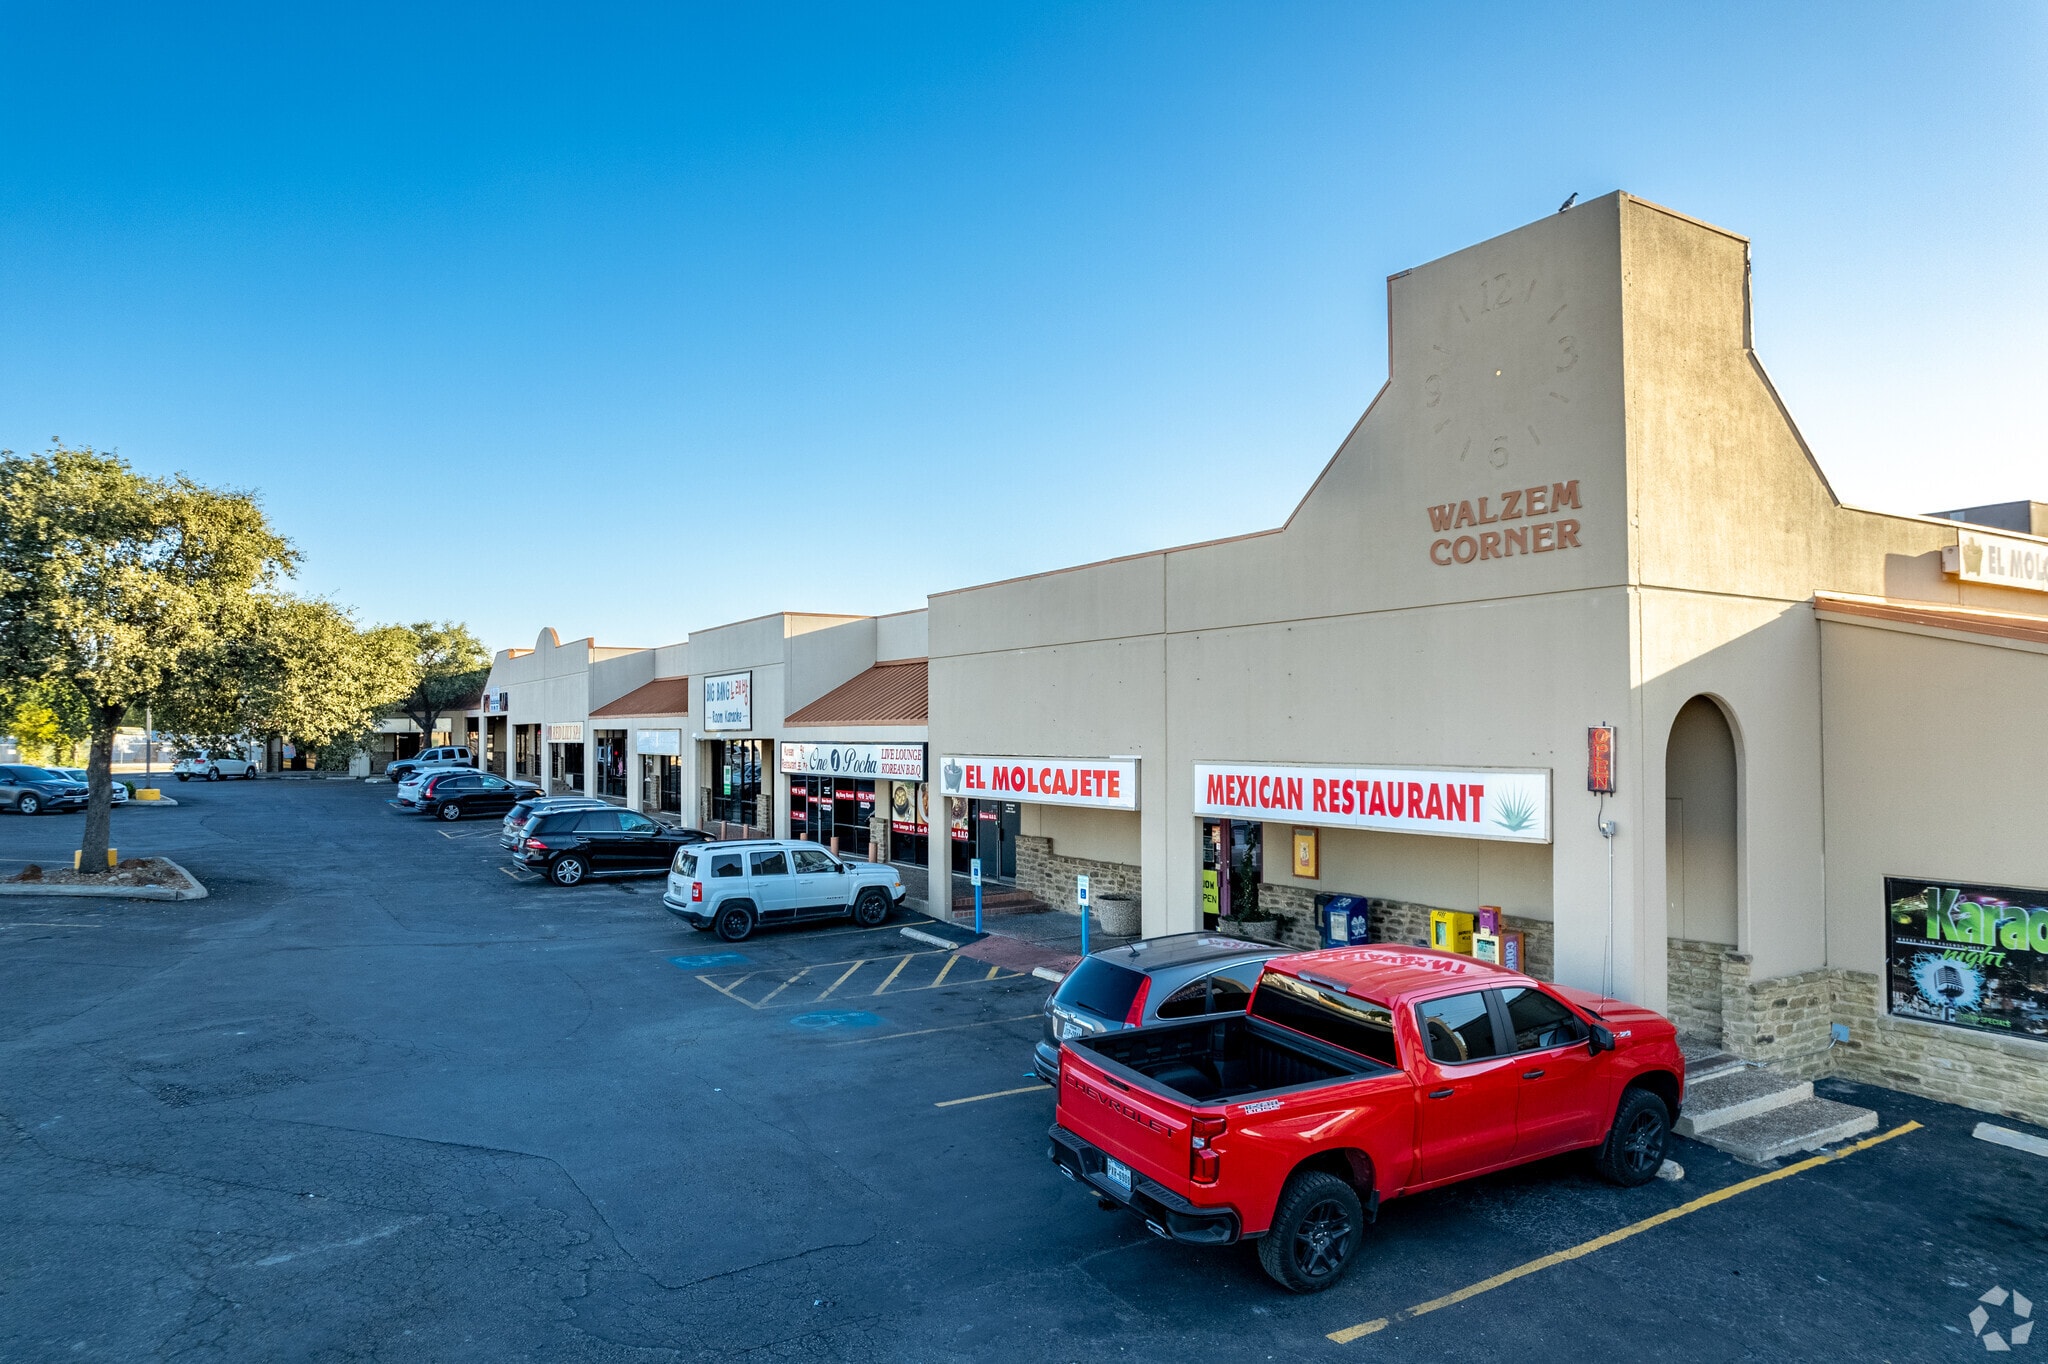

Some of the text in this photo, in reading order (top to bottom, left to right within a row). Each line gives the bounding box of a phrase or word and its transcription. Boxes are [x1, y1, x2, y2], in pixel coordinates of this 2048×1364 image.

[1427, 480, 1582, 532] WALZEM
[1429, 518, 1582, 566] CORNER
[1988, 545, 2005, 576] EL
[706, 682, 714, 702] BIG
[717, 681, 730, 701] BANG
[810, 747, 828, 771] One
[842, 747, 878, 775] Pocha
[881, 748, 922, 761] LIVE LOUNGE
[881, 763, 905, 775] KOREAN
[965, 765, 1120, 798] EL MOLCAJETE
[1206, 774, 1485, 823] MEXICAN RESTAURANT
[1943, 945, 2006, 970] night
[1065, 1073, 1177, 1138] CHEVROLET
